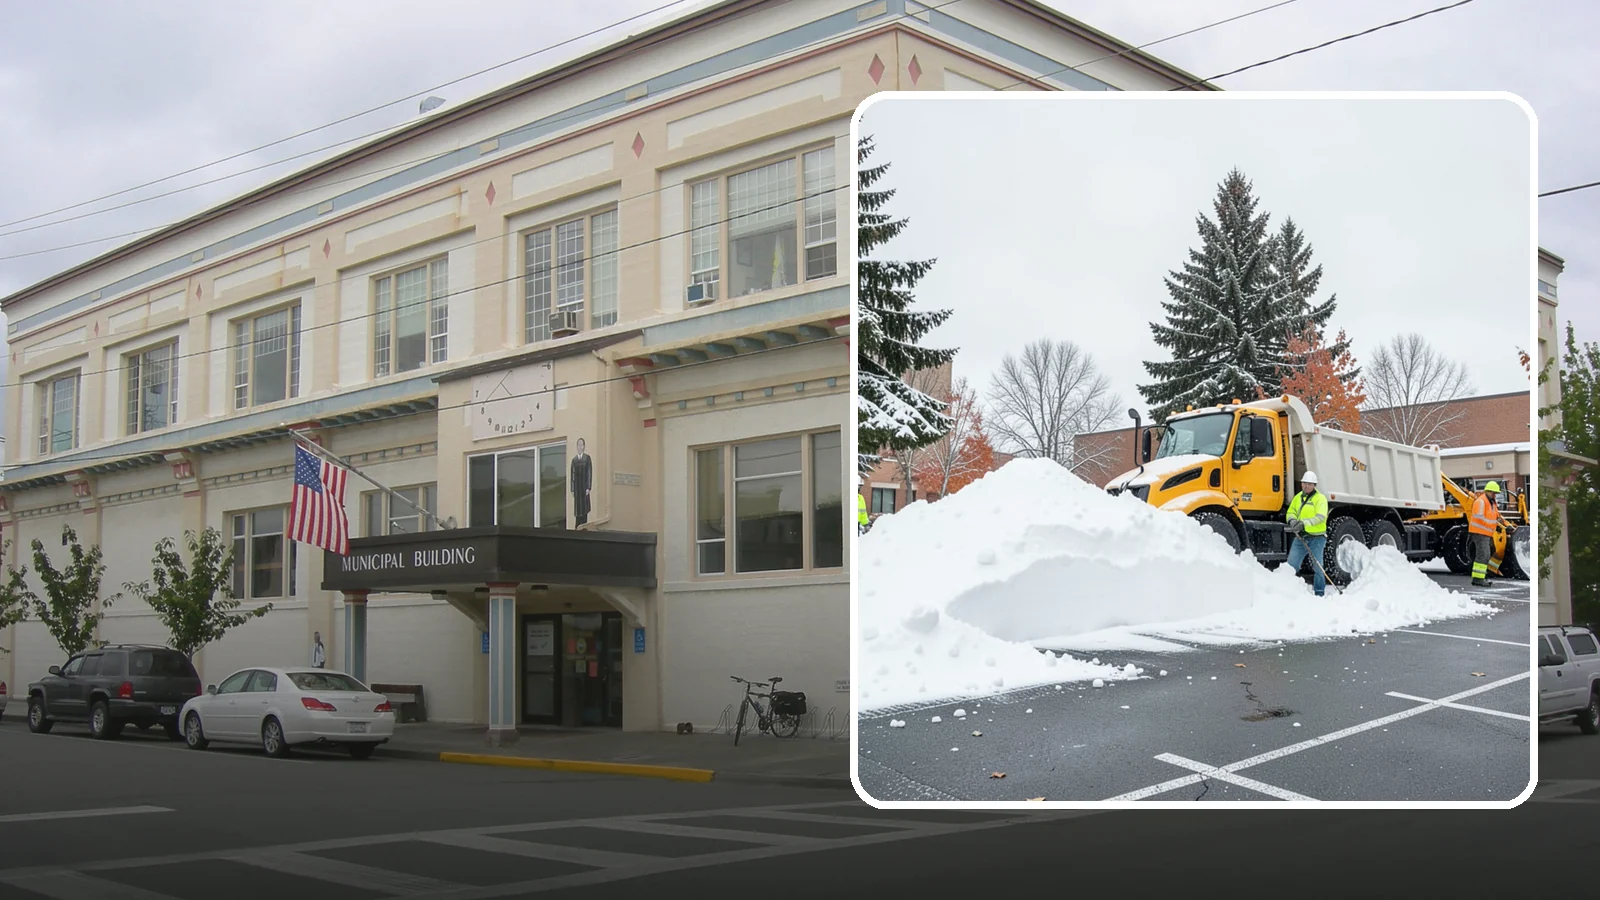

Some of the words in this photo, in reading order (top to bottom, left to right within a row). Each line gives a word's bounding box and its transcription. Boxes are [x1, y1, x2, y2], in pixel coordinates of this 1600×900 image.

[546, 362, 552, 370] 6
[475, 390, 479, 398] 7
[480, 407, 485, 415] 8
[488, 417, 492, 426] 9
[529, 414, 533, 422] 3
[495, 423, 500, 432] 10
[521, 420, 526, 428] 2
[507, 425, 513, 433] 12
[342, 552, 405, 571] MUNICIPAL
[414, 546, 475, 567] BUILDING
